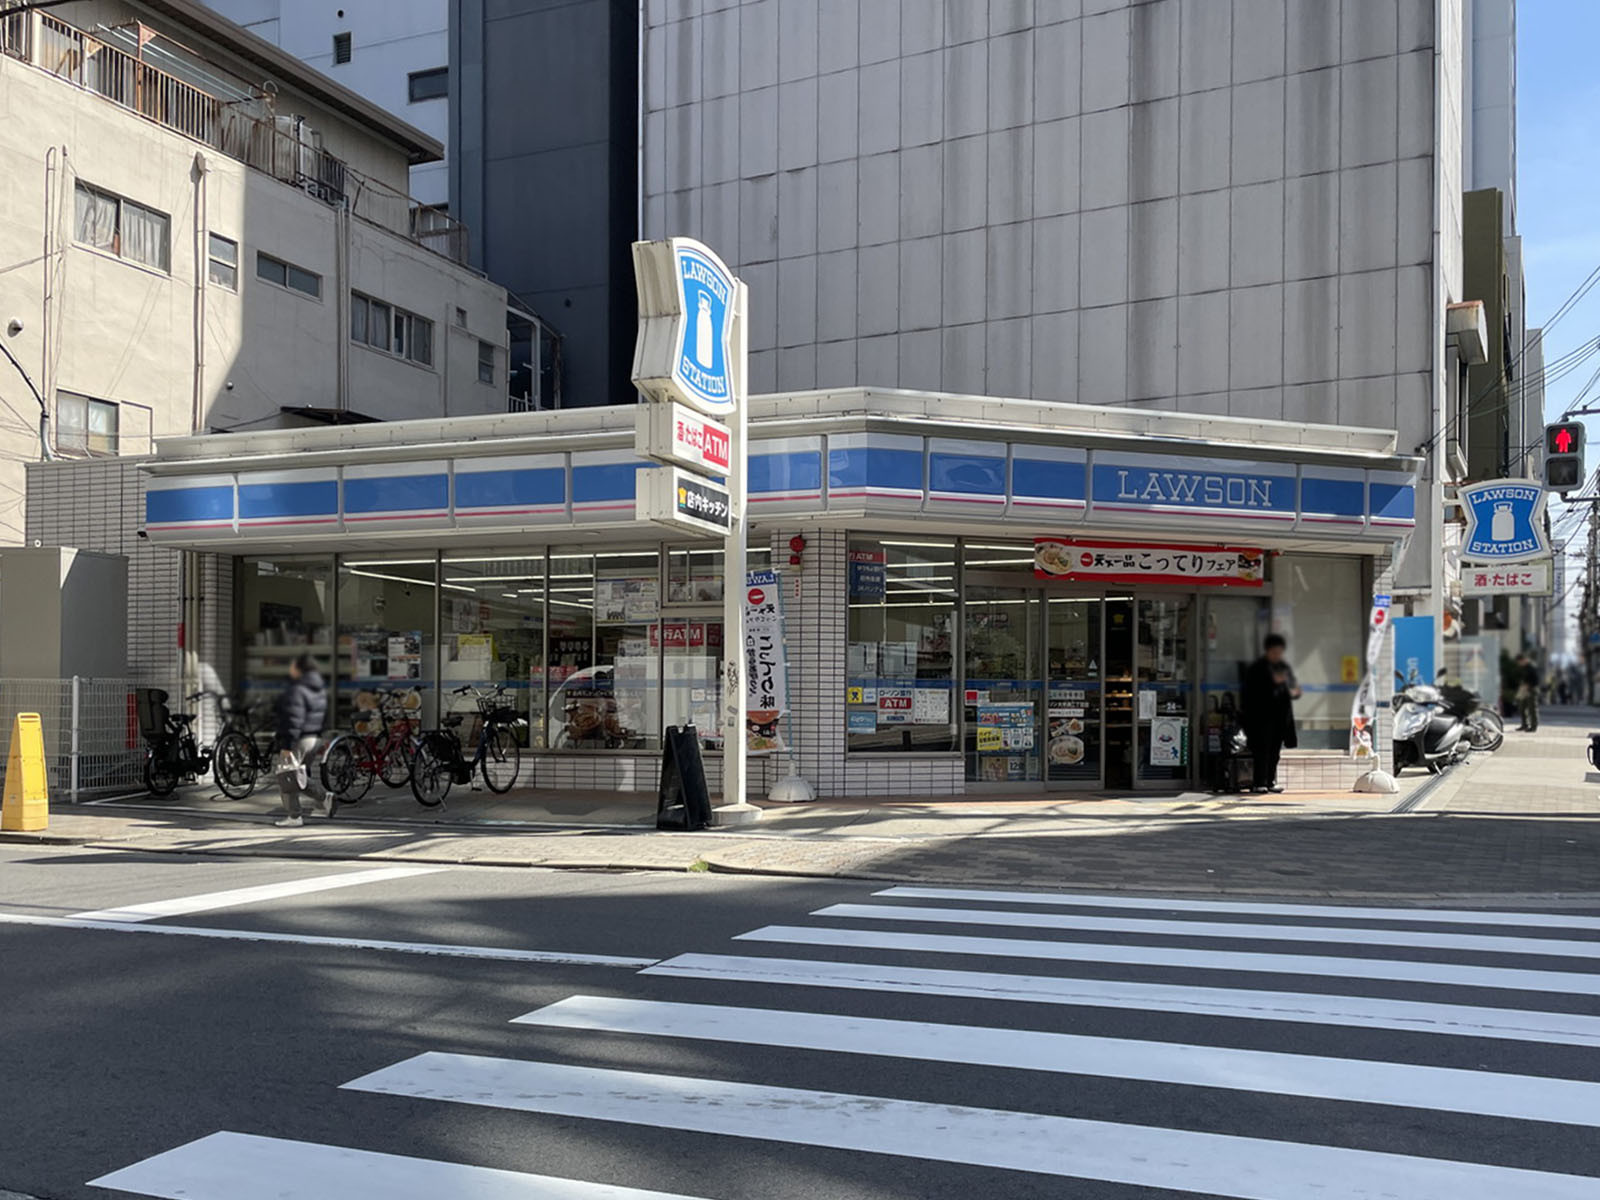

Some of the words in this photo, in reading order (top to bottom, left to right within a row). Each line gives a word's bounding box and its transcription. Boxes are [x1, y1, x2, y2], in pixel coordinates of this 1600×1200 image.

[682, 261, 727, 304] LAWSON
[680, 356, 726, 395] STATION
[704, 432, 728, 460] ATM
[1117, 470, 1272, 507] LAWSON
[1472, 489, 1535, 504] LAWSON
[687, 490, 728, 518] 店内キッチン
[1472, 539, 1534, 553] STATION
[1138, 552, 1237, 574] こってりフェア
[884, 698, 908, 708] ATM
